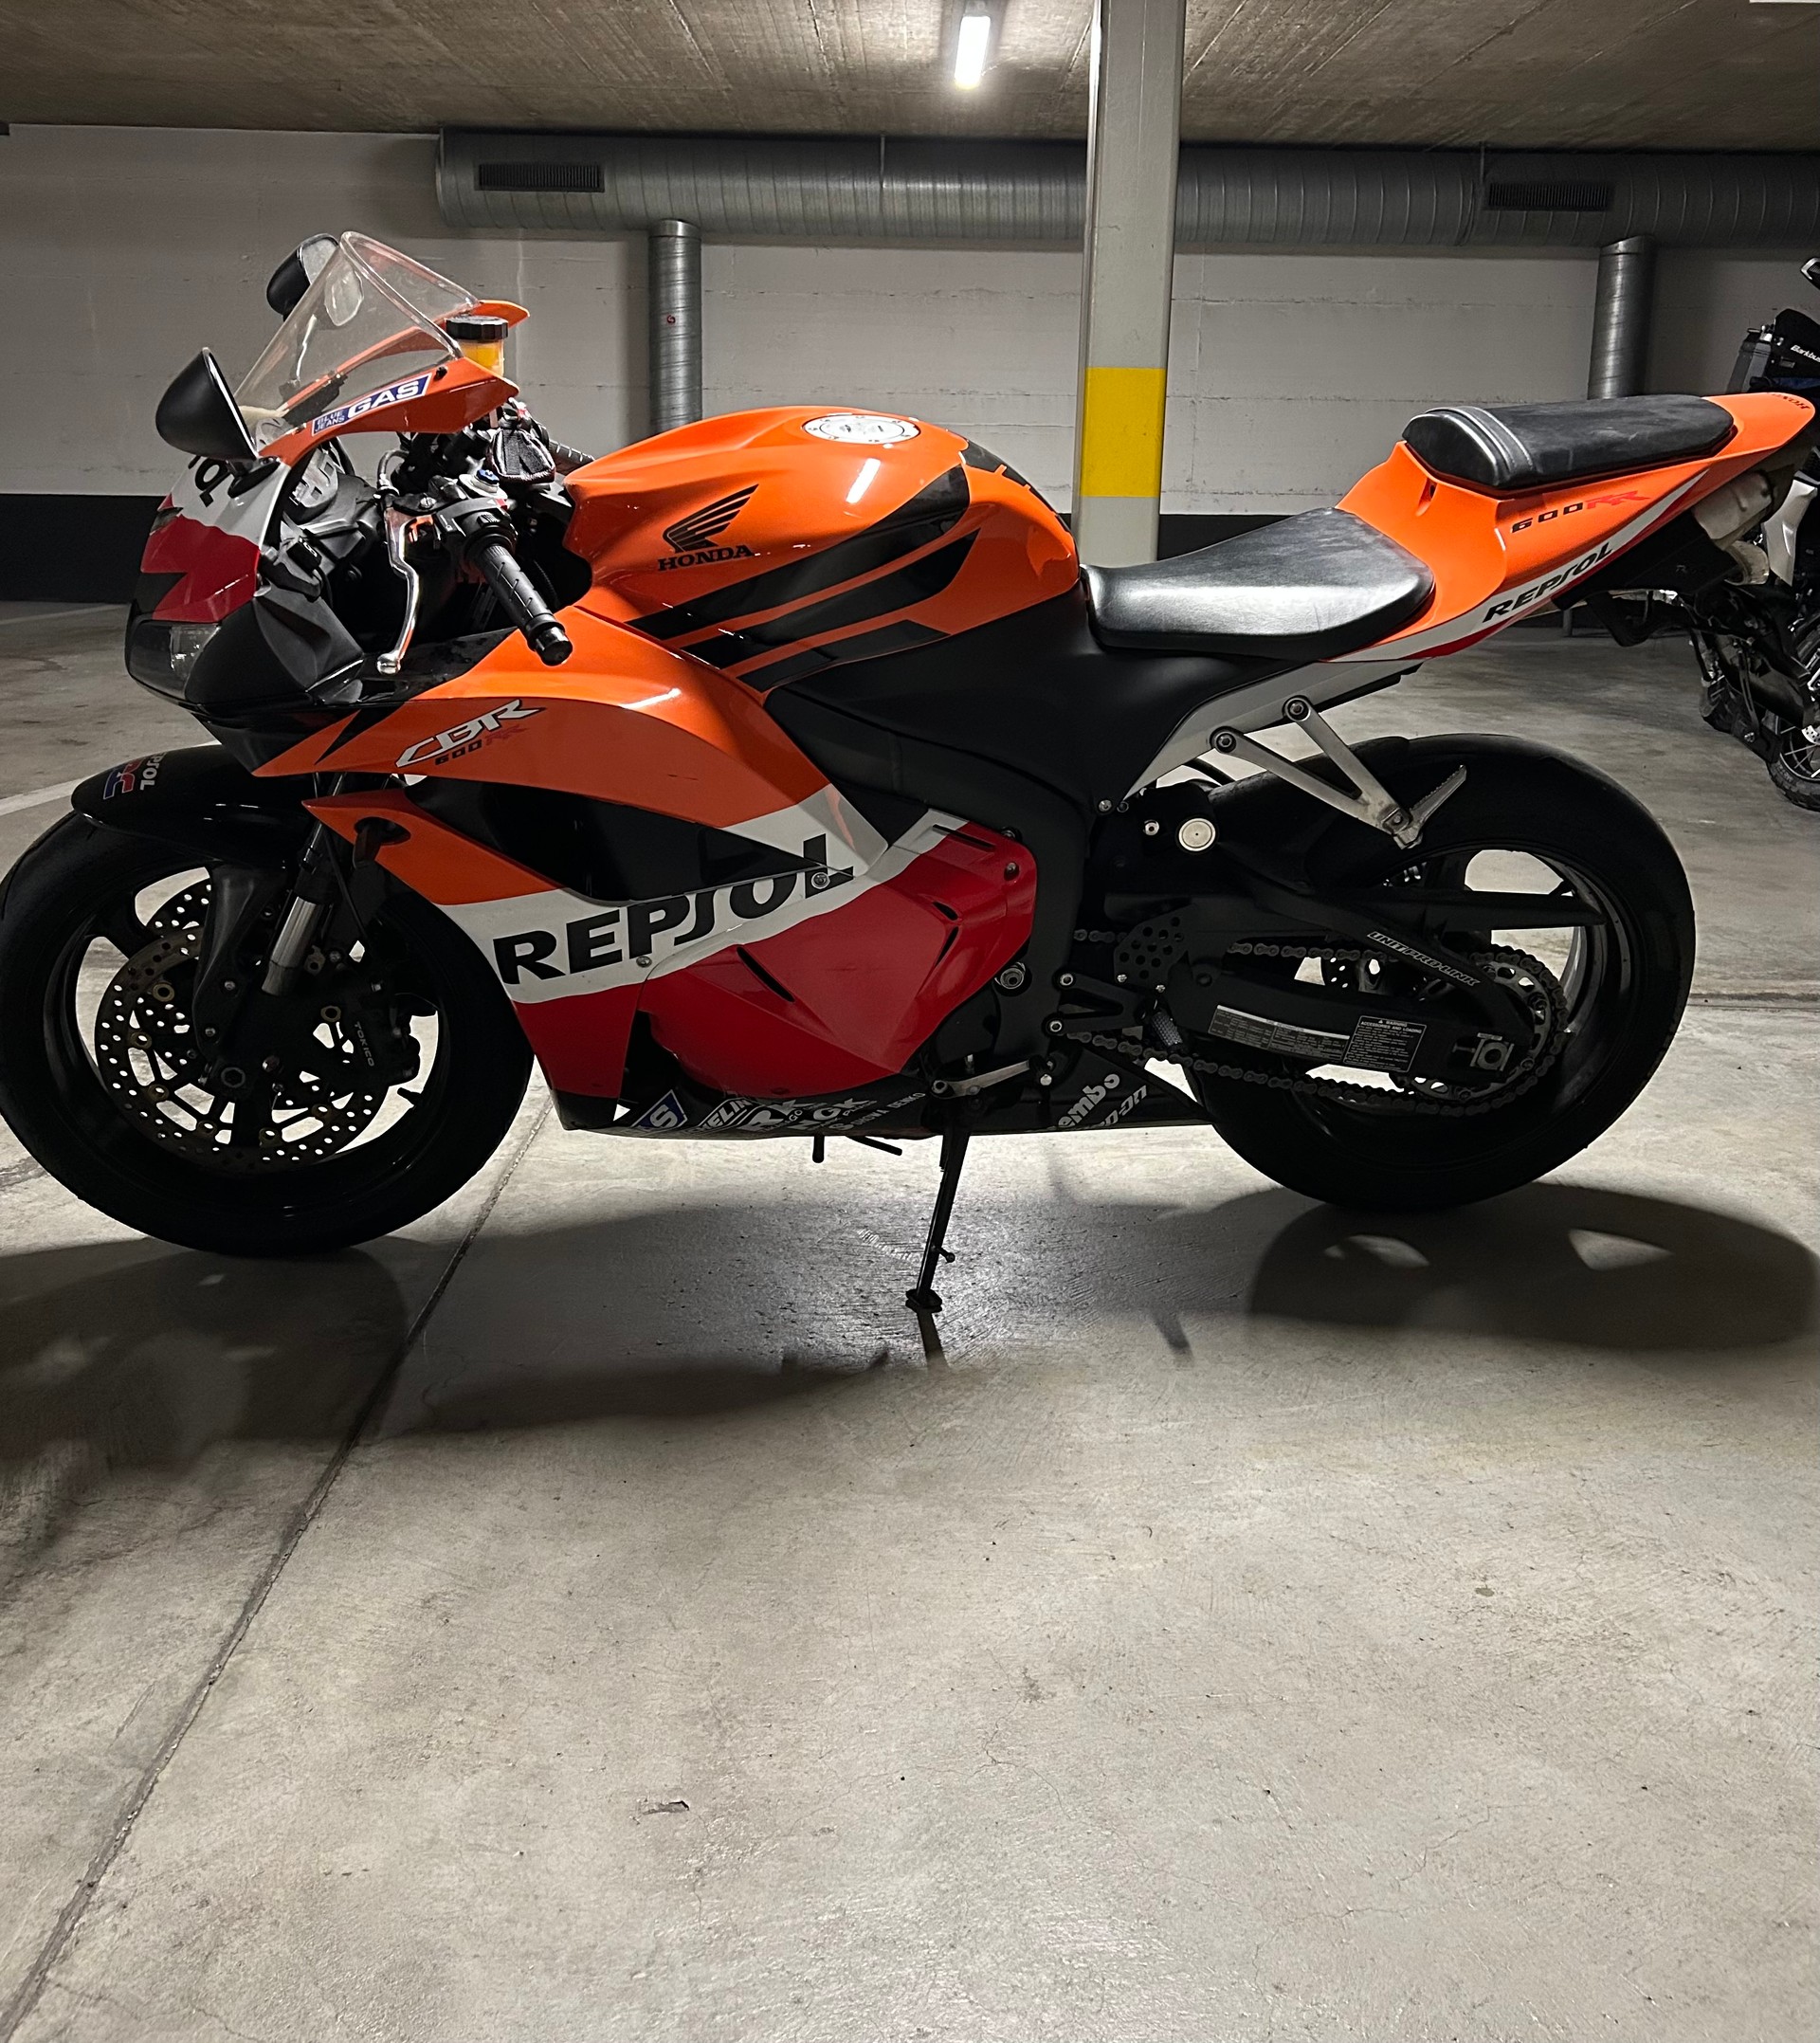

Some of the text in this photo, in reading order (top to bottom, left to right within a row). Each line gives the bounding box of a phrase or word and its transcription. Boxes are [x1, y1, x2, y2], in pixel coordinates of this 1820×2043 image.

[347, 379, 420, 419] GAS
[314, 415, 345, 432] JEANS
[1511, 490, 1651, 534] 600RR
[658, 544, 755, 572] HONDA
[1482, 541, 1614, 624] REPSOL
[395, 699, 543, 768] CBR
[492, 832, 855, 986] REPSOL
[1366, 930, 1410, 954] UNIT
[354, 1020, 375, 1067] TOKICO
